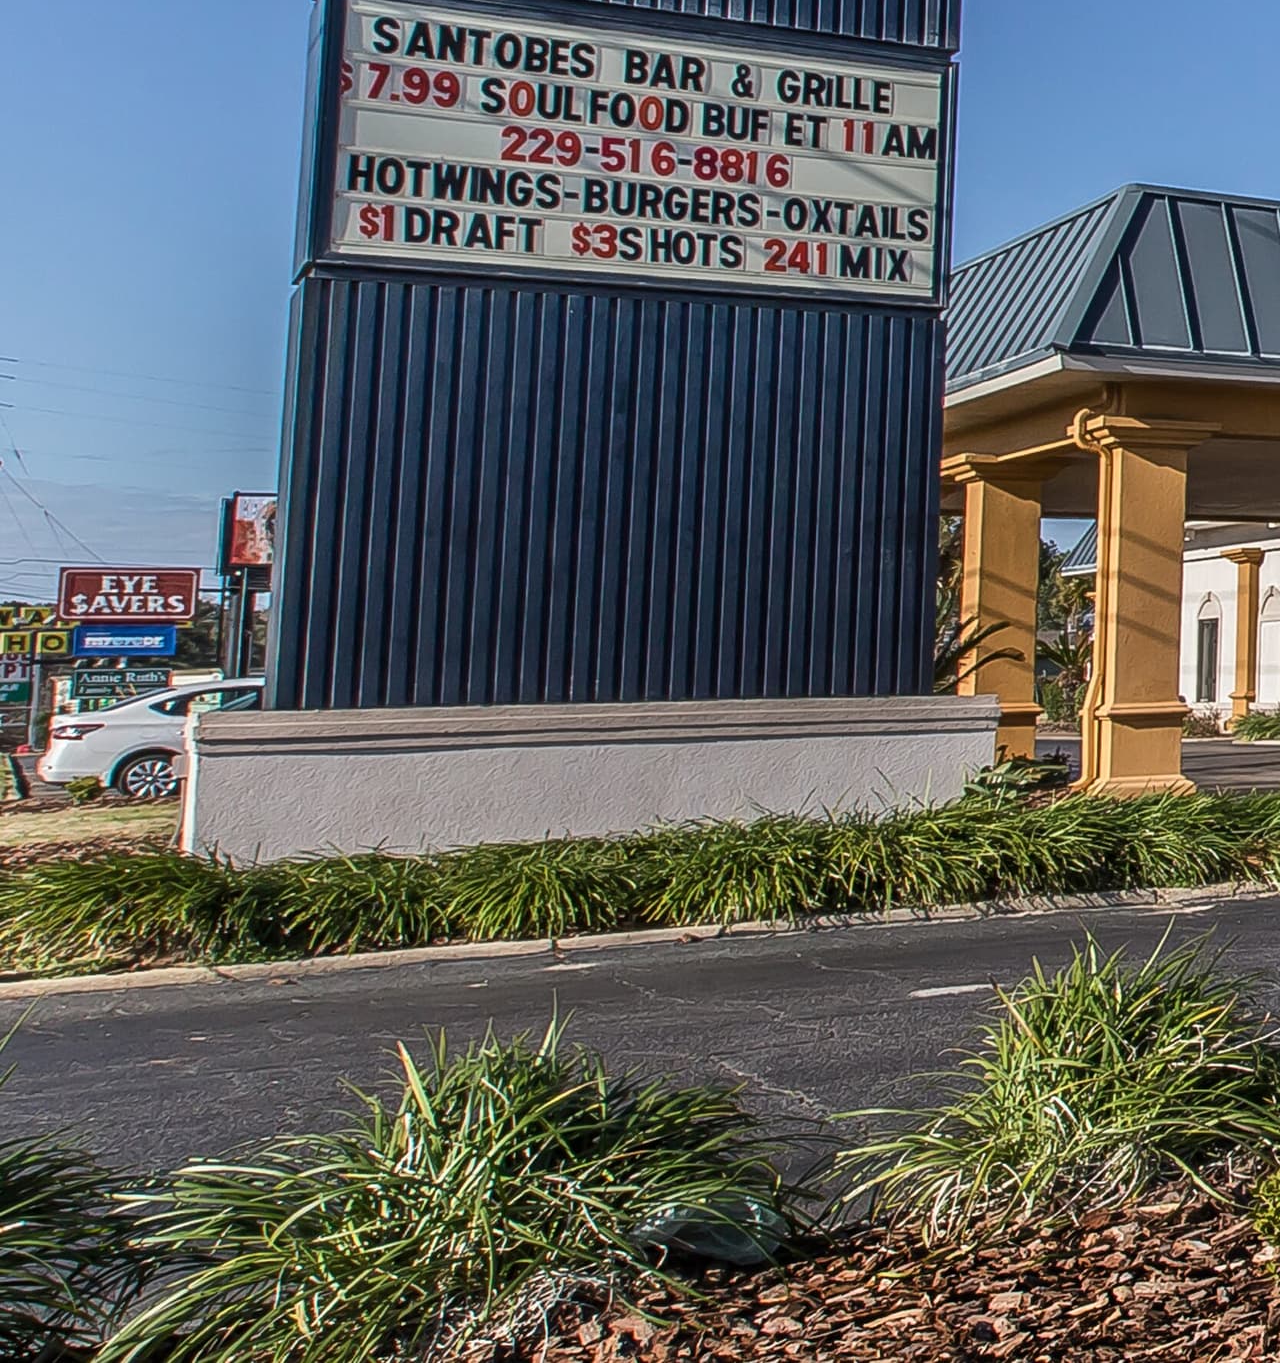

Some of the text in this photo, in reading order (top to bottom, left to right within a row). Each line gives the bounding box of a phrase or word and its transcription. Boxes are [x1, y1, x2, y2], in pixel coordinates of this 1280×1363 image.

[372, 16, 892, 114] SANTOBES BAR & GRILLE
[98, 575, 159, 594] EYE
[80, 673, 123, 683] Annie
